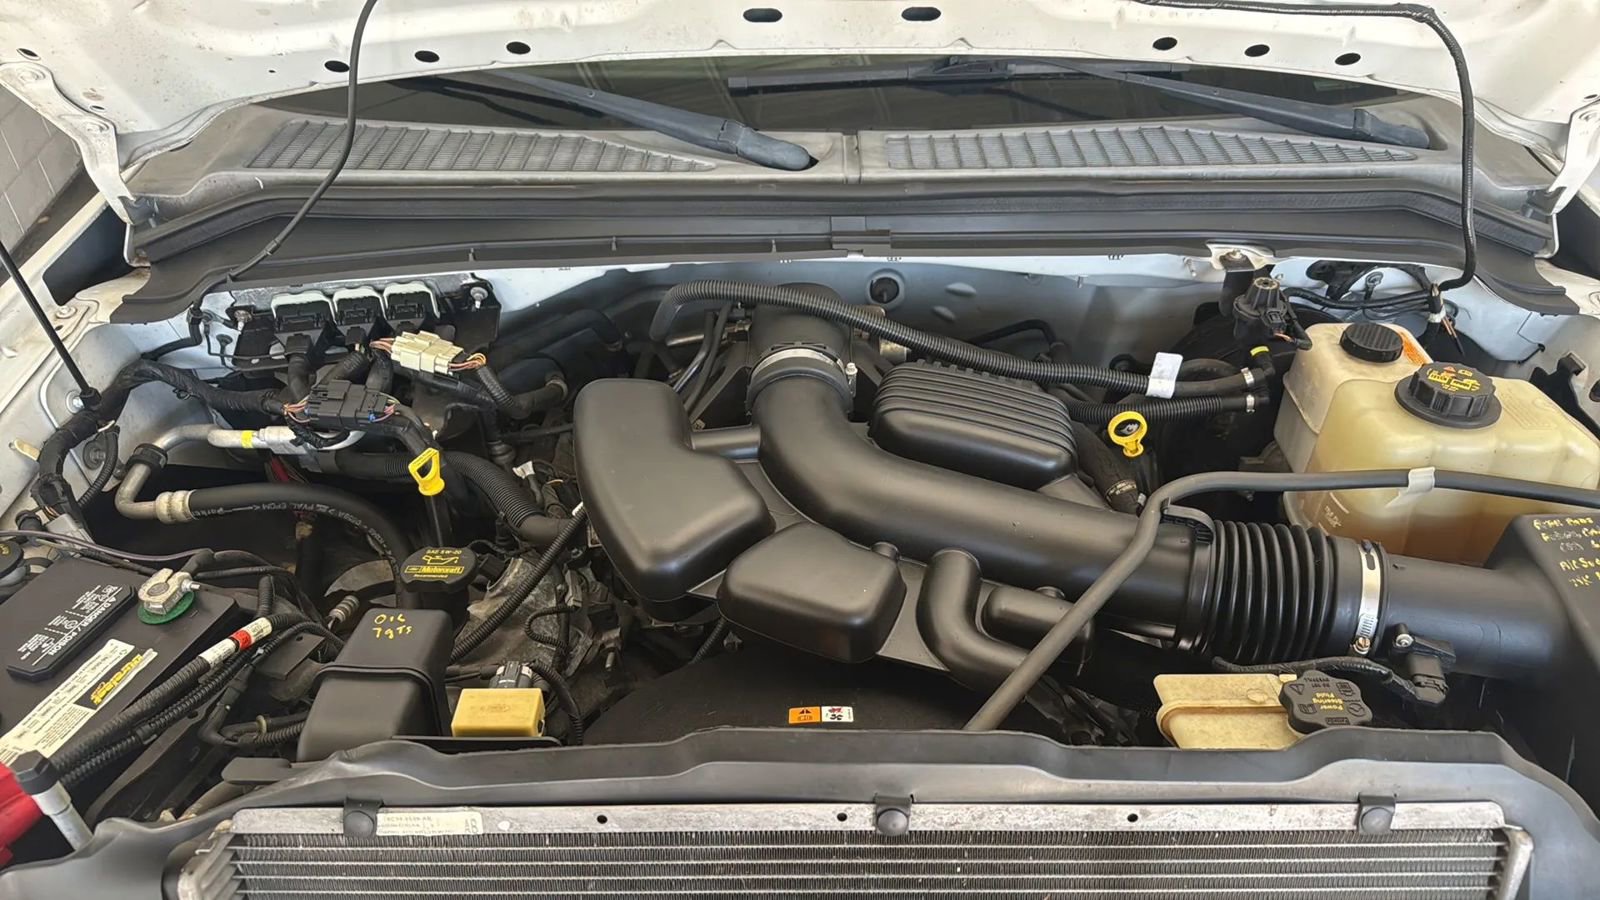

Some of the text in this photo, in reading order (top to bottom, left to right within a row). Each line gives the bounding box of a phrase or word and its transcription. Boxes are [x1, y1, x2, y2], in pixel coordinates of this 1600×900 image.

[421, 565, 460, 574] Motorcraft
[80, 602, 112, 627] DANGER
[47, 631, 78, 656] POISON
